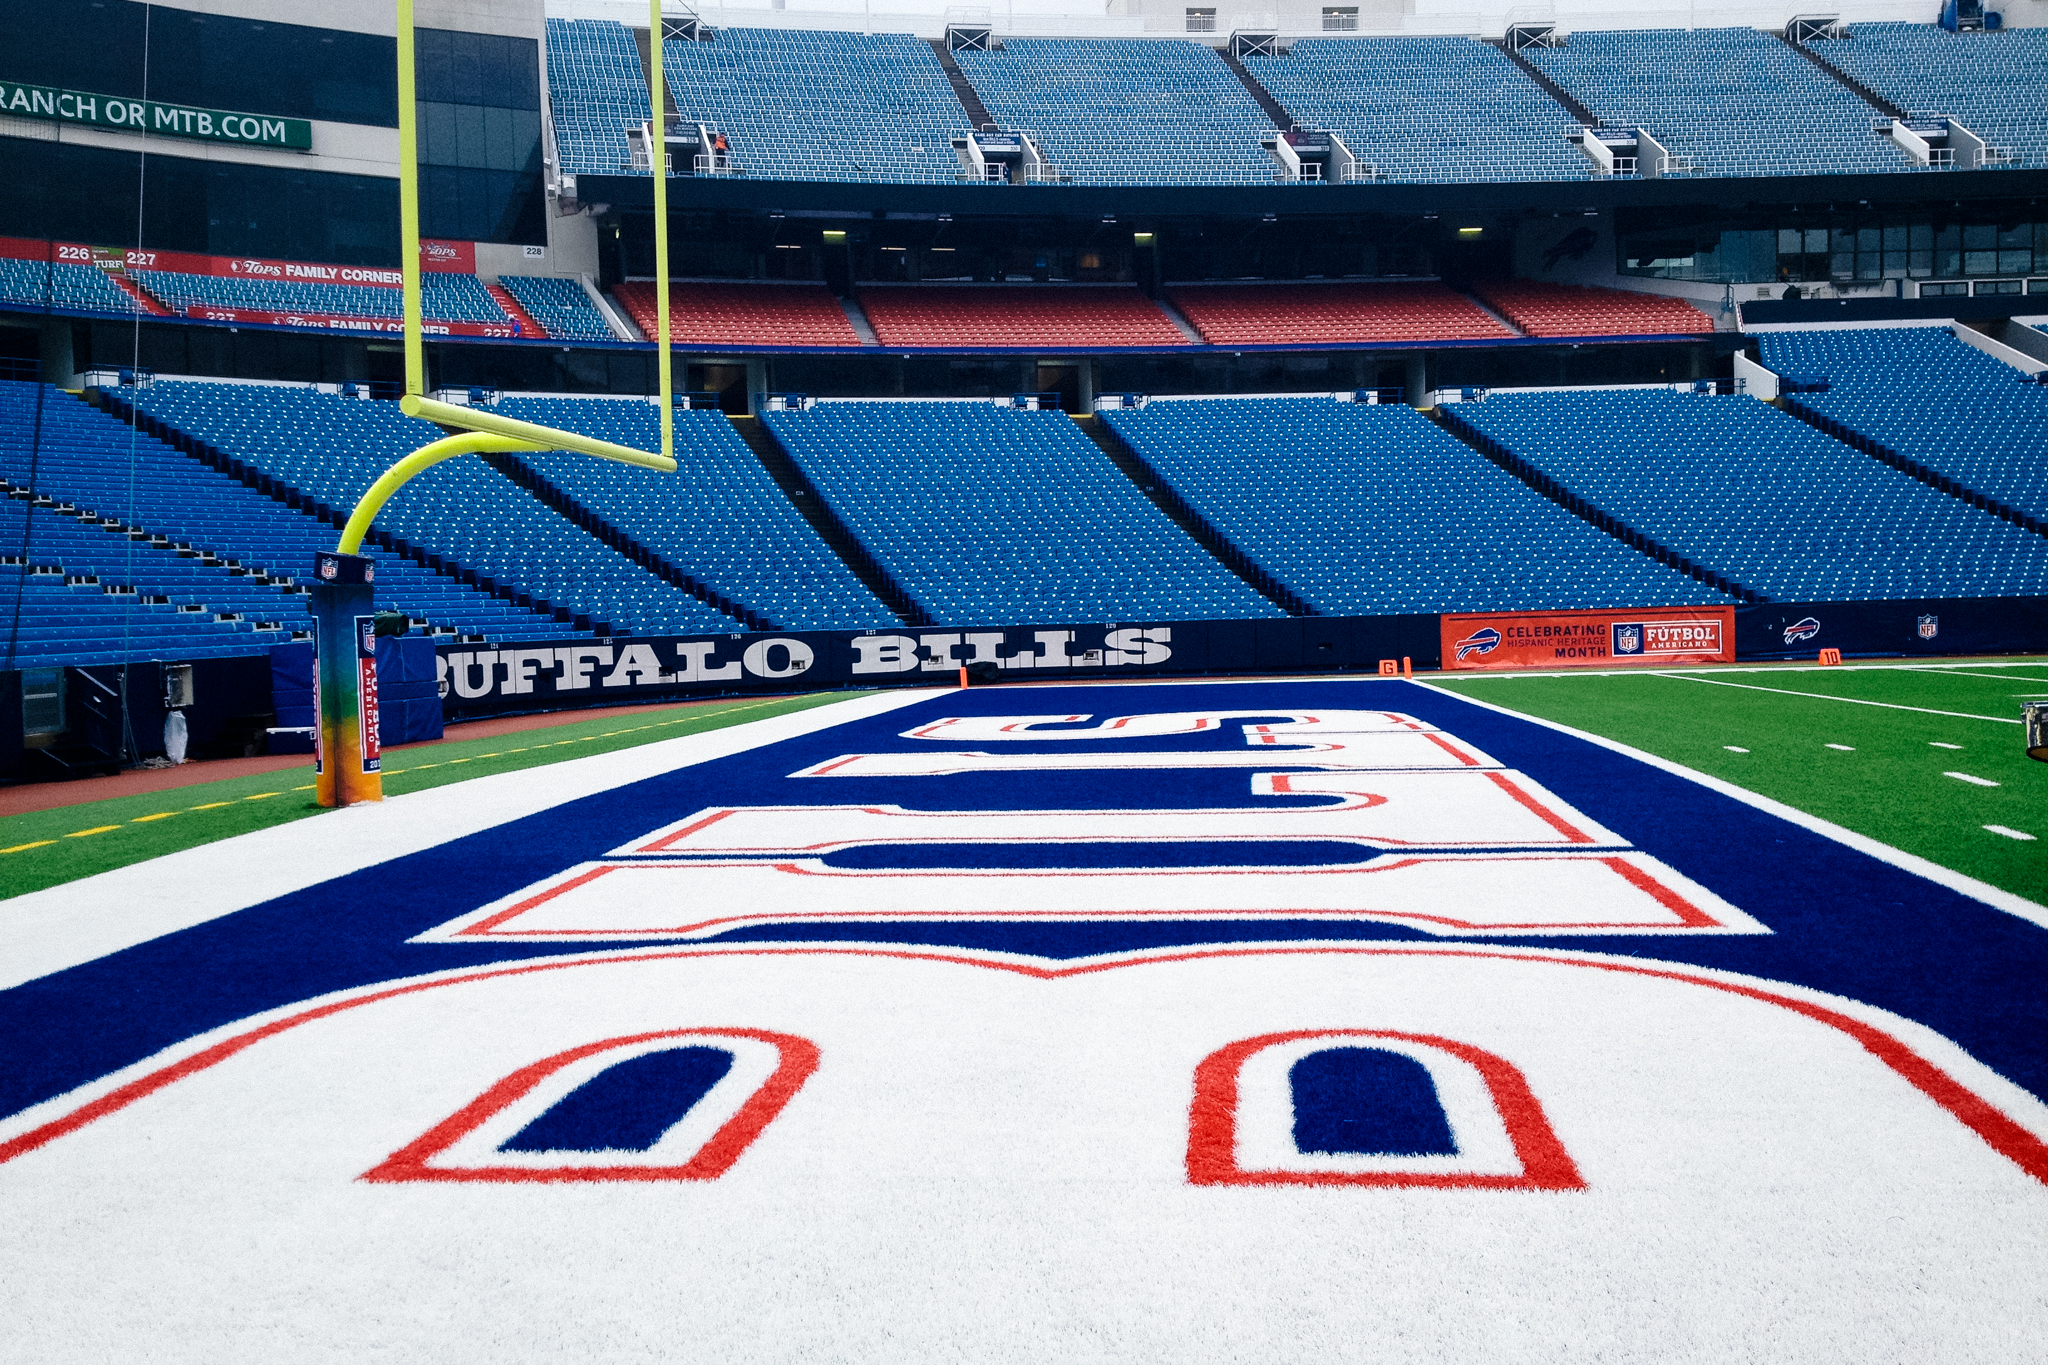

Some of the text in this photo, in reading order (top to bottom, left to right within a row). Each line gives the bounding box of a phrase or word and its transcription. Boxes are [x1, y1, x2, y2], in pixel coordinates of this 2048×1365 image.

[105, 100, 146, 126] OR
[154, 106, 286, 142] MTB.COM
[58, 246, 90, 260] 226
[126, 251, 156, 265] 227
[526, 247, 542, 255] 228
[286, 264, 338, 279] FAMILY
[341, 268, 403, 284] CORNER
[387, 322, 450, 335] CONER
[1507, 624, 1606, 639] CELEBRATING
[1647, 626, 1715, 642] FÚTBOL
[1507, 636, 1606, 648] HISPANIC HERITAGE
[1652, 640, 1707, 648] AMERICANO
[1555, 647, 1606, 658] MONTH
[1824, 651, 1839, 664] 10
[436, 627, 1172, 699] UFFALO BILLS
[1383, 661, 1394, 675] G
[365, 668, 375, 743] AMERICANO
